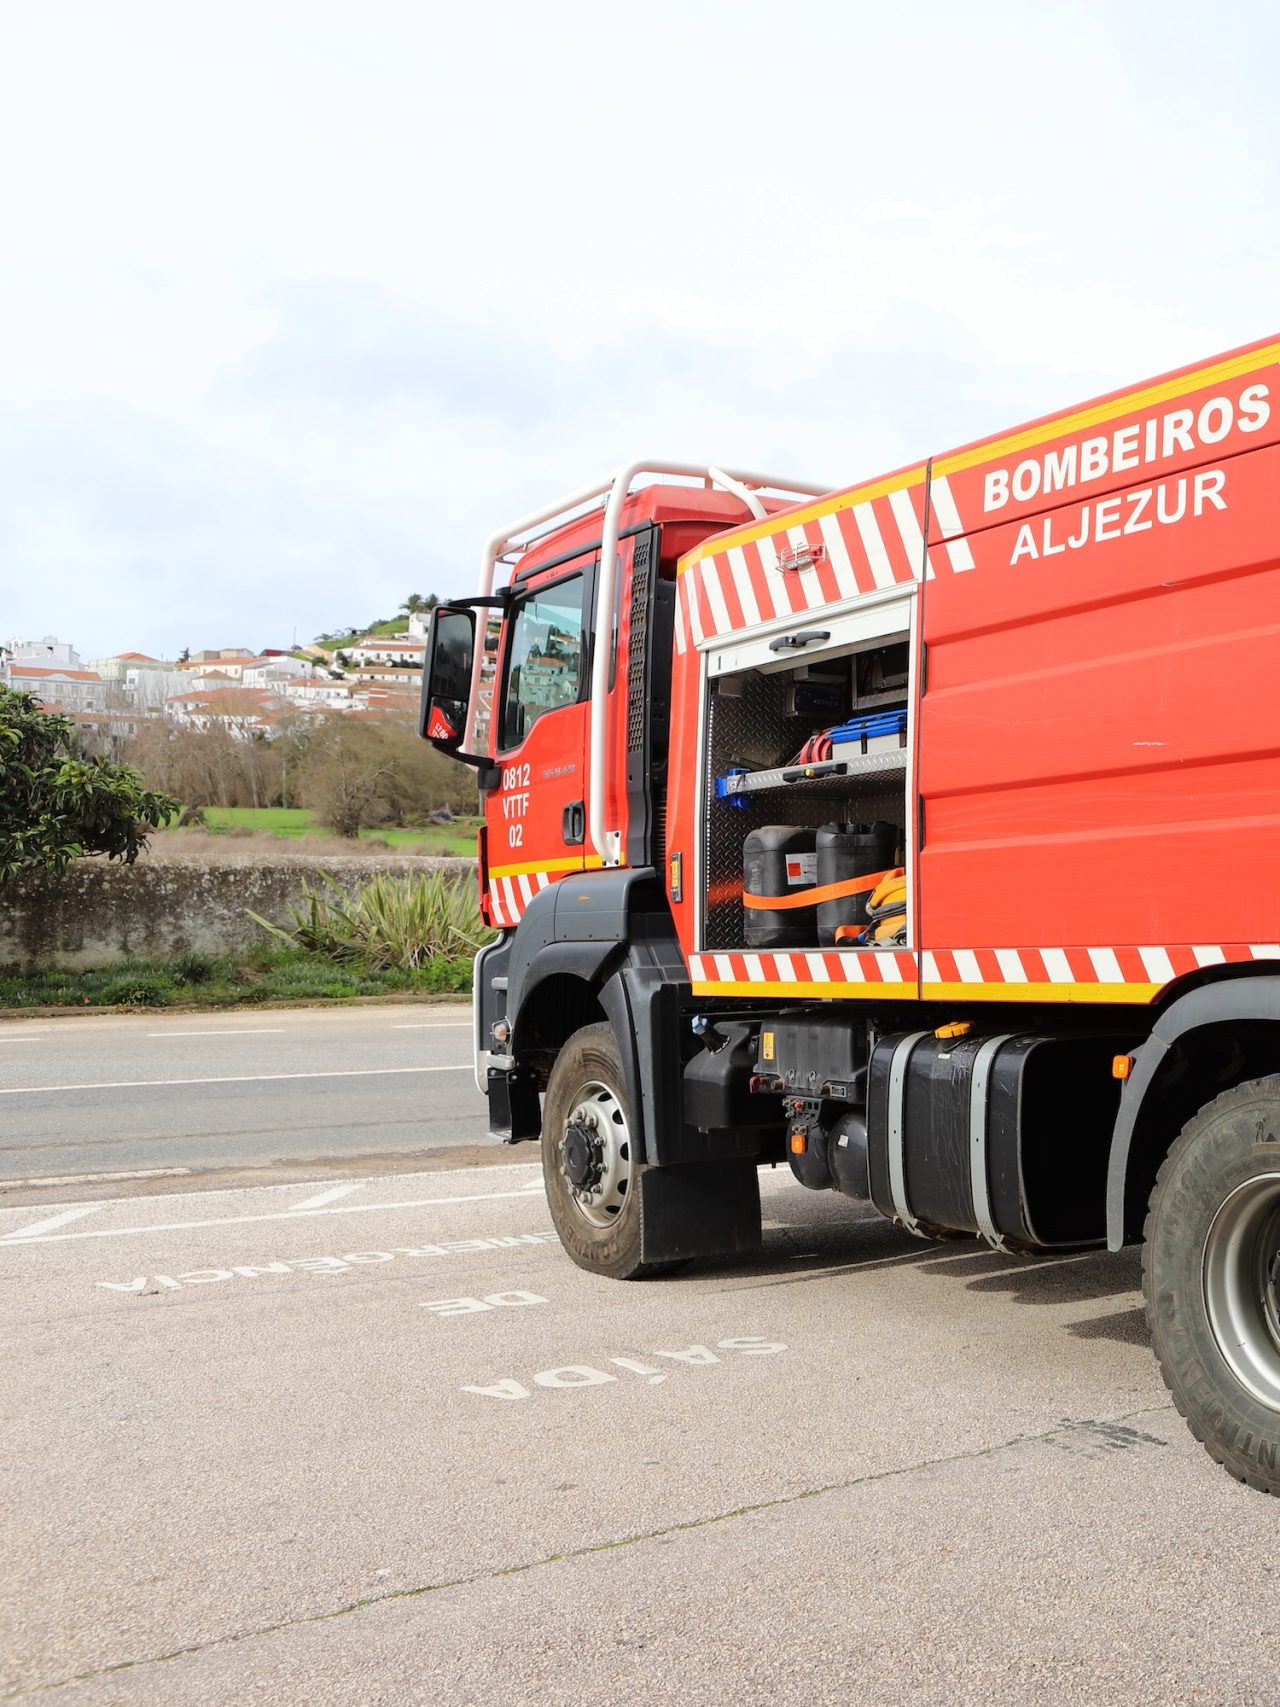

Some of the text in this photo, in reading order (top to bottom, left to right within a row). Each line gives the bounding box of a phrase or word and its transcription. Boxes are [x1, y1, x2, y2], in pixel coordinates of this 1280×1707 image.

[983, 383, 1271, 513] BOMBEIROS
[1009, 469, 1228, 566] ALJEZUR
[503, 763, 530, 791] 0812
[502, 793, 529, 819] VTTF
[509, 823, 523, 848] 02
[420, 1290, 549, 1316] DE
[459, 1336, 789, 1400] SAÍDA
